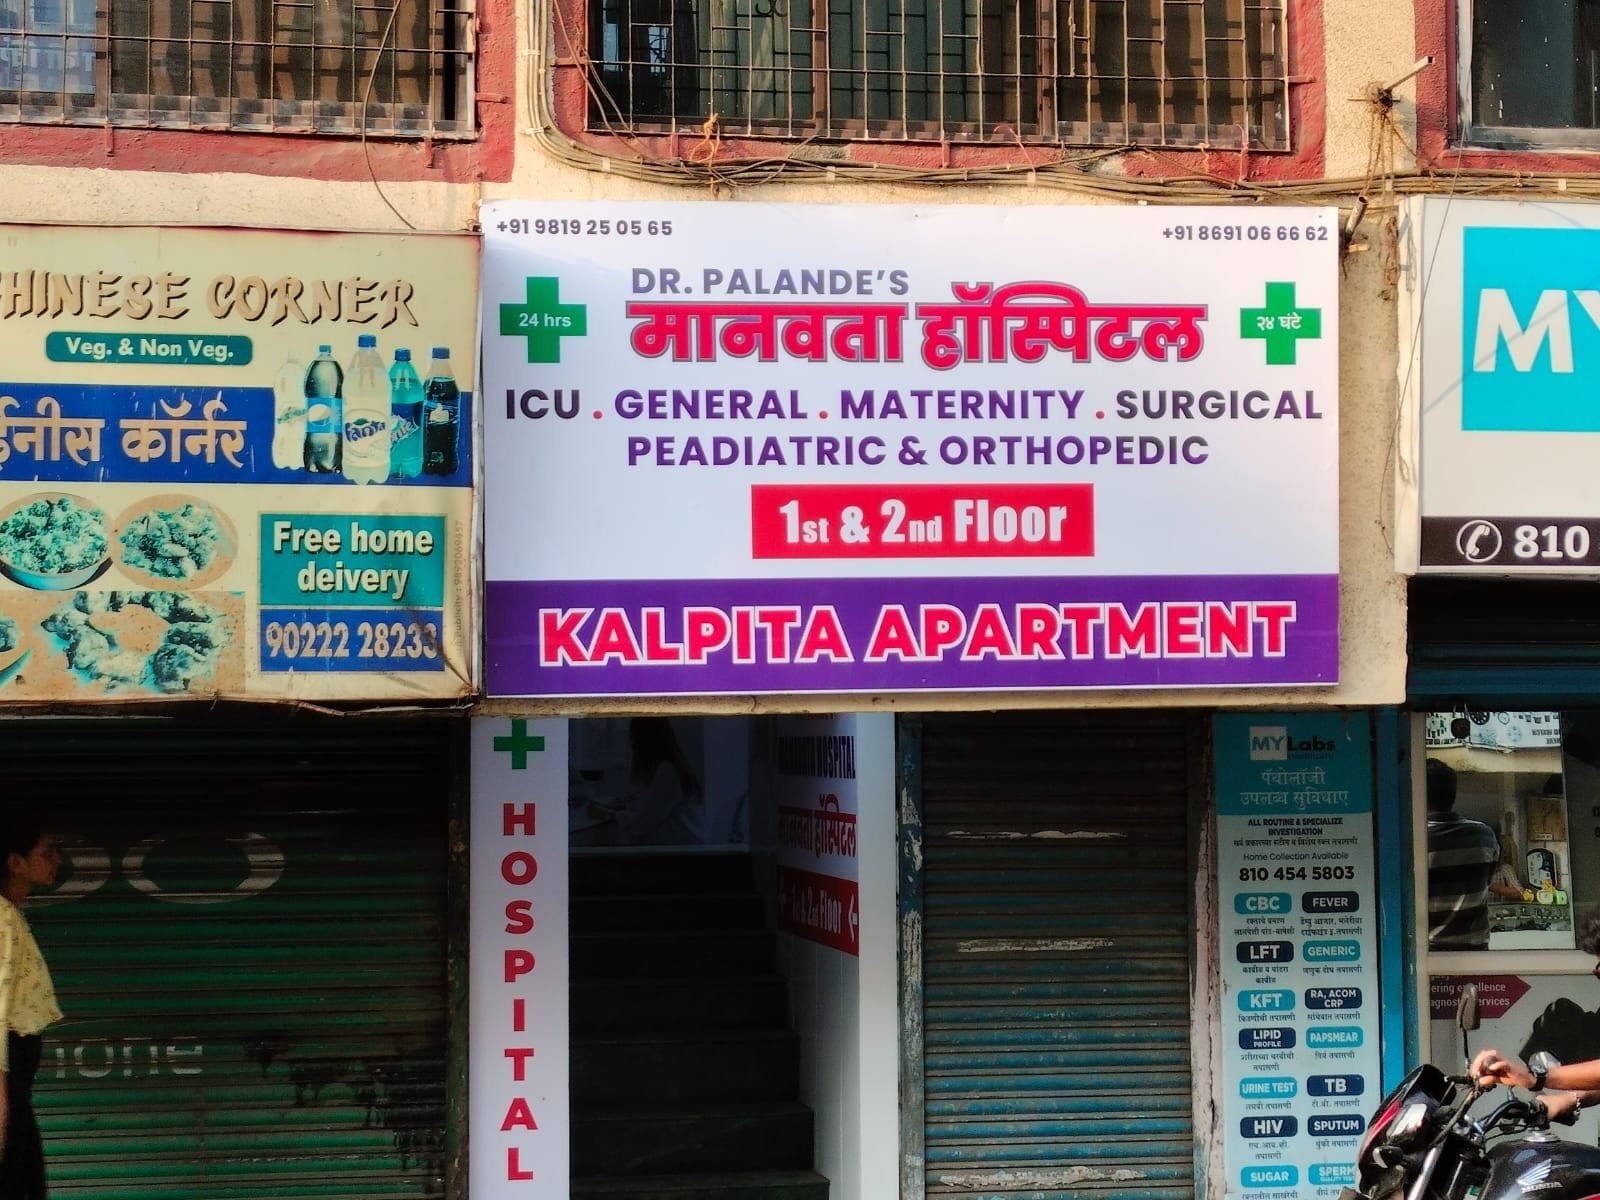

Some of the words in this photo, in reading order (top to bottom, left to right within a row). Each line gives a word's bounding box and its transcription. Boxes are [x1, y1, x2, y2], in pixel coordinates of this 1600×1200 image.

[497, 218, 528, 234] +91
[535, 218, 580, 235] 9819
[587, 219, 611, 235] 25
[616, 220, 642, 235] 05
[648, 220, 673, 236] 65
[1163, 226, 1193, 241] +91
[1198, 226, 1242, 241] 8691
[1247, 226, 1271, 241] 06
[1277, 226, 1300, 241] 66
[1305, 226, 1328, 241] 62
[632, 268, 693, 294] DR.
[0, 269, 191, 322] HINESE
[207, 274, 419, 328] CORNER
[519, 313, 540, 328] 24
[543, 313, 571, 328] hrs
[626, 300, 909, 363] मानवता
[915, 280, 1209, 372] हॉस्पिटल
[1256, 316, 1274, 331] २४
[1278, 314, 1302, 331] घंटे
[65, 337, 112, 361] Veg.
[118, 339, 134, 357] &
[139, 339, 182, 358] Non
[187, 340, 234, 362] Veg.
[506, 389, 581, 420] ICU
[614, 389, 808, 420] GENERAL
[841, 389, 1085, 420] MATERNITY
[1116, 389, 1323, 420] SURGICAL
[120, 391, 247, 470] कॉर्नर
[628, 435, 887, 466] PEADIATRIC
[898, 436, 928, 466] &
[939, 435, 1209, 466] ORTHOPEDIC
[779, 500, 830, 545] 1st
[840, 503, 870, 543] &
[880, 499, 943, 543] 2nd
[954, 497, 1067, 542] Floor
[273, 521, 341, 553] Free
[350, 522, 434, 554] home
[1514, 525, 1590, 559] 810
[297, 561, 409, 600] deivery
[265, 622, 349, 659] 90222
[539, 602, 853, 667] KALPITA
[864, 600, 1297, 664] APARTMENT
[1252, 736, 1285, 750] MY
[1287, 736, 1336, 751] Labs
[1263, 818, 1294, 826] ROUTINE
[1302, 817, 1343, 825] SPECIALIZE
[1268, 828, 1323, 836] INVESTIGATION
[1243, 853, 1267, 861] Home
[1269, 852, 1310, 861] Collection
[1311, 851, 1349, 860] Available
[1239, 867, 1269, 881] 810
[1273, 866, 1307, 880] 454
[1311, 866, 1355, 880] 5803
[1246, 896, 1280, 911] CBC
[1312, 897, 1348, 908] FEVER
[1250, 944, 1280, 960] LFT
[1308, 945, 1355, 957] GENERIC
[1336, 964, 1362, 973] तपासणी
[501, 802, 538, 1181] HOSPITAL
[1310, 990, 1326, 999] RA,
[1329, 989, 1357, 998] ACOM
[1250, 993, 1282, 1008] KFT
[1324, 999, 1343, 1008] CRP
[1269, 1013, 1296, 1021] तपासणी
[1334, 1011, 1361, 1020] तपासणी
[1253, 1030, 1282, 1040] LIPID
[1310, 1032, 1358, 1043] PAPSMEAR
[1253, 1062, 1279, 1071] तपासणी
[1242, 1083, 1270, 1094] URINE
[1272, 1082, 1294, 1093] TEST
[1324, 1078, 1347, 1093] TB
[1265, 1100, 1292, 1110] तपासणी
[1333, 1098, 1360, 1108] तपासणी
[1254, 1119, 1284, 1135] HIV
[1314, 1120, 1359, 1131] SPUTUM
[1331, 1138, 1358, 1147] तपासणी
[1255, 1150, 1282, 1160] तपासणी
[1250, 1171, 1289, 1182] SUGAR
